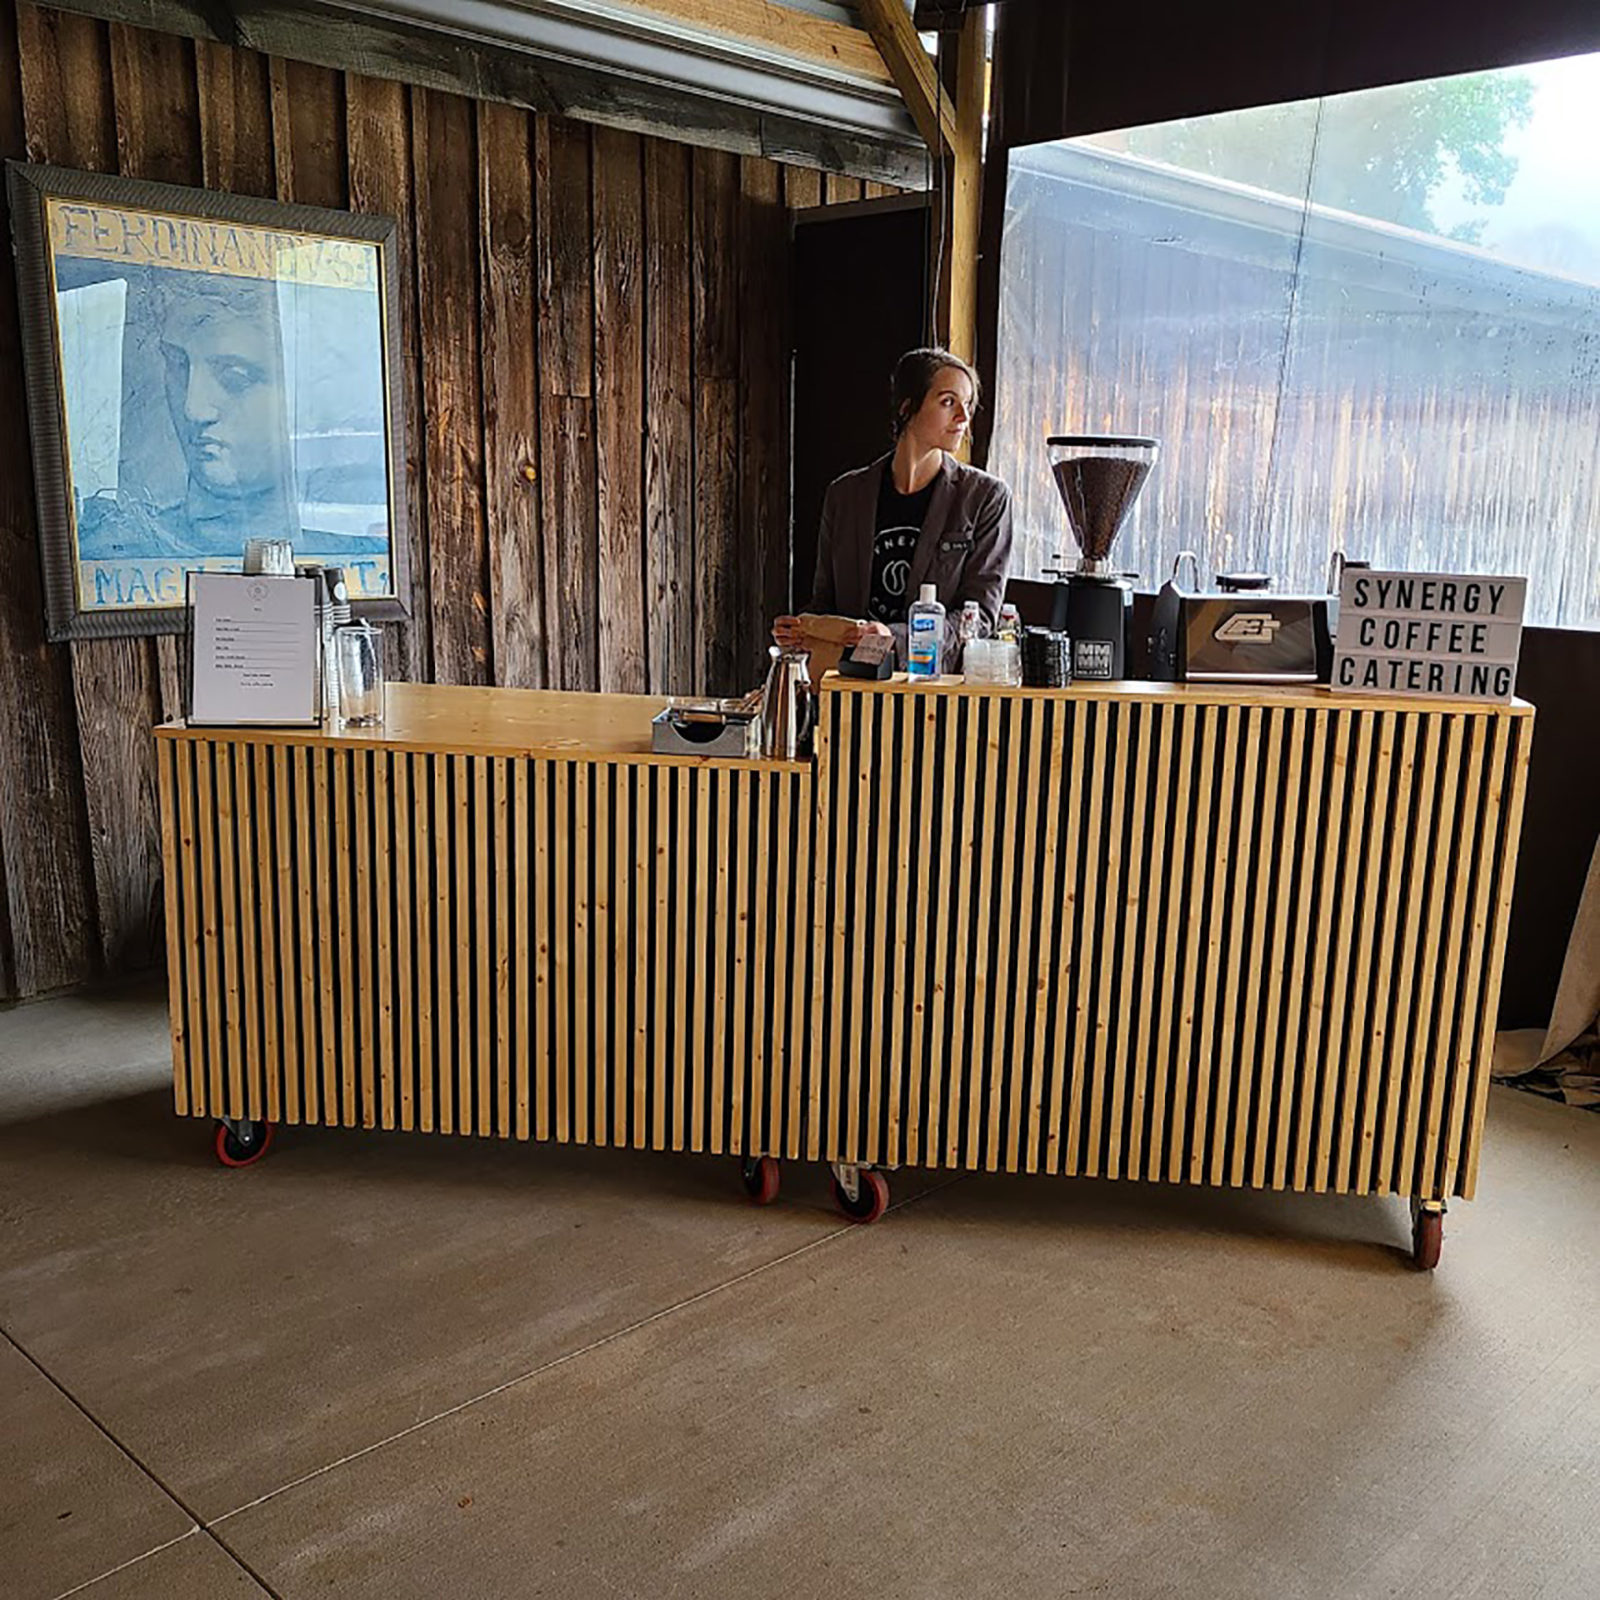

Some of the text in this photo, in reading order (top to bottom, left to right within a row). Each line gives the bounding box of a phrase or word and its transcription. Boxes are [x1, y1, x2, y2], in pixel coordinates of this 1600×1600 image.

[1354, 578, 1505, 614] SYNERGY
[1359, 617, 1487, 653] COFFEE
[1339, 657, 1511, 696] CATERING
